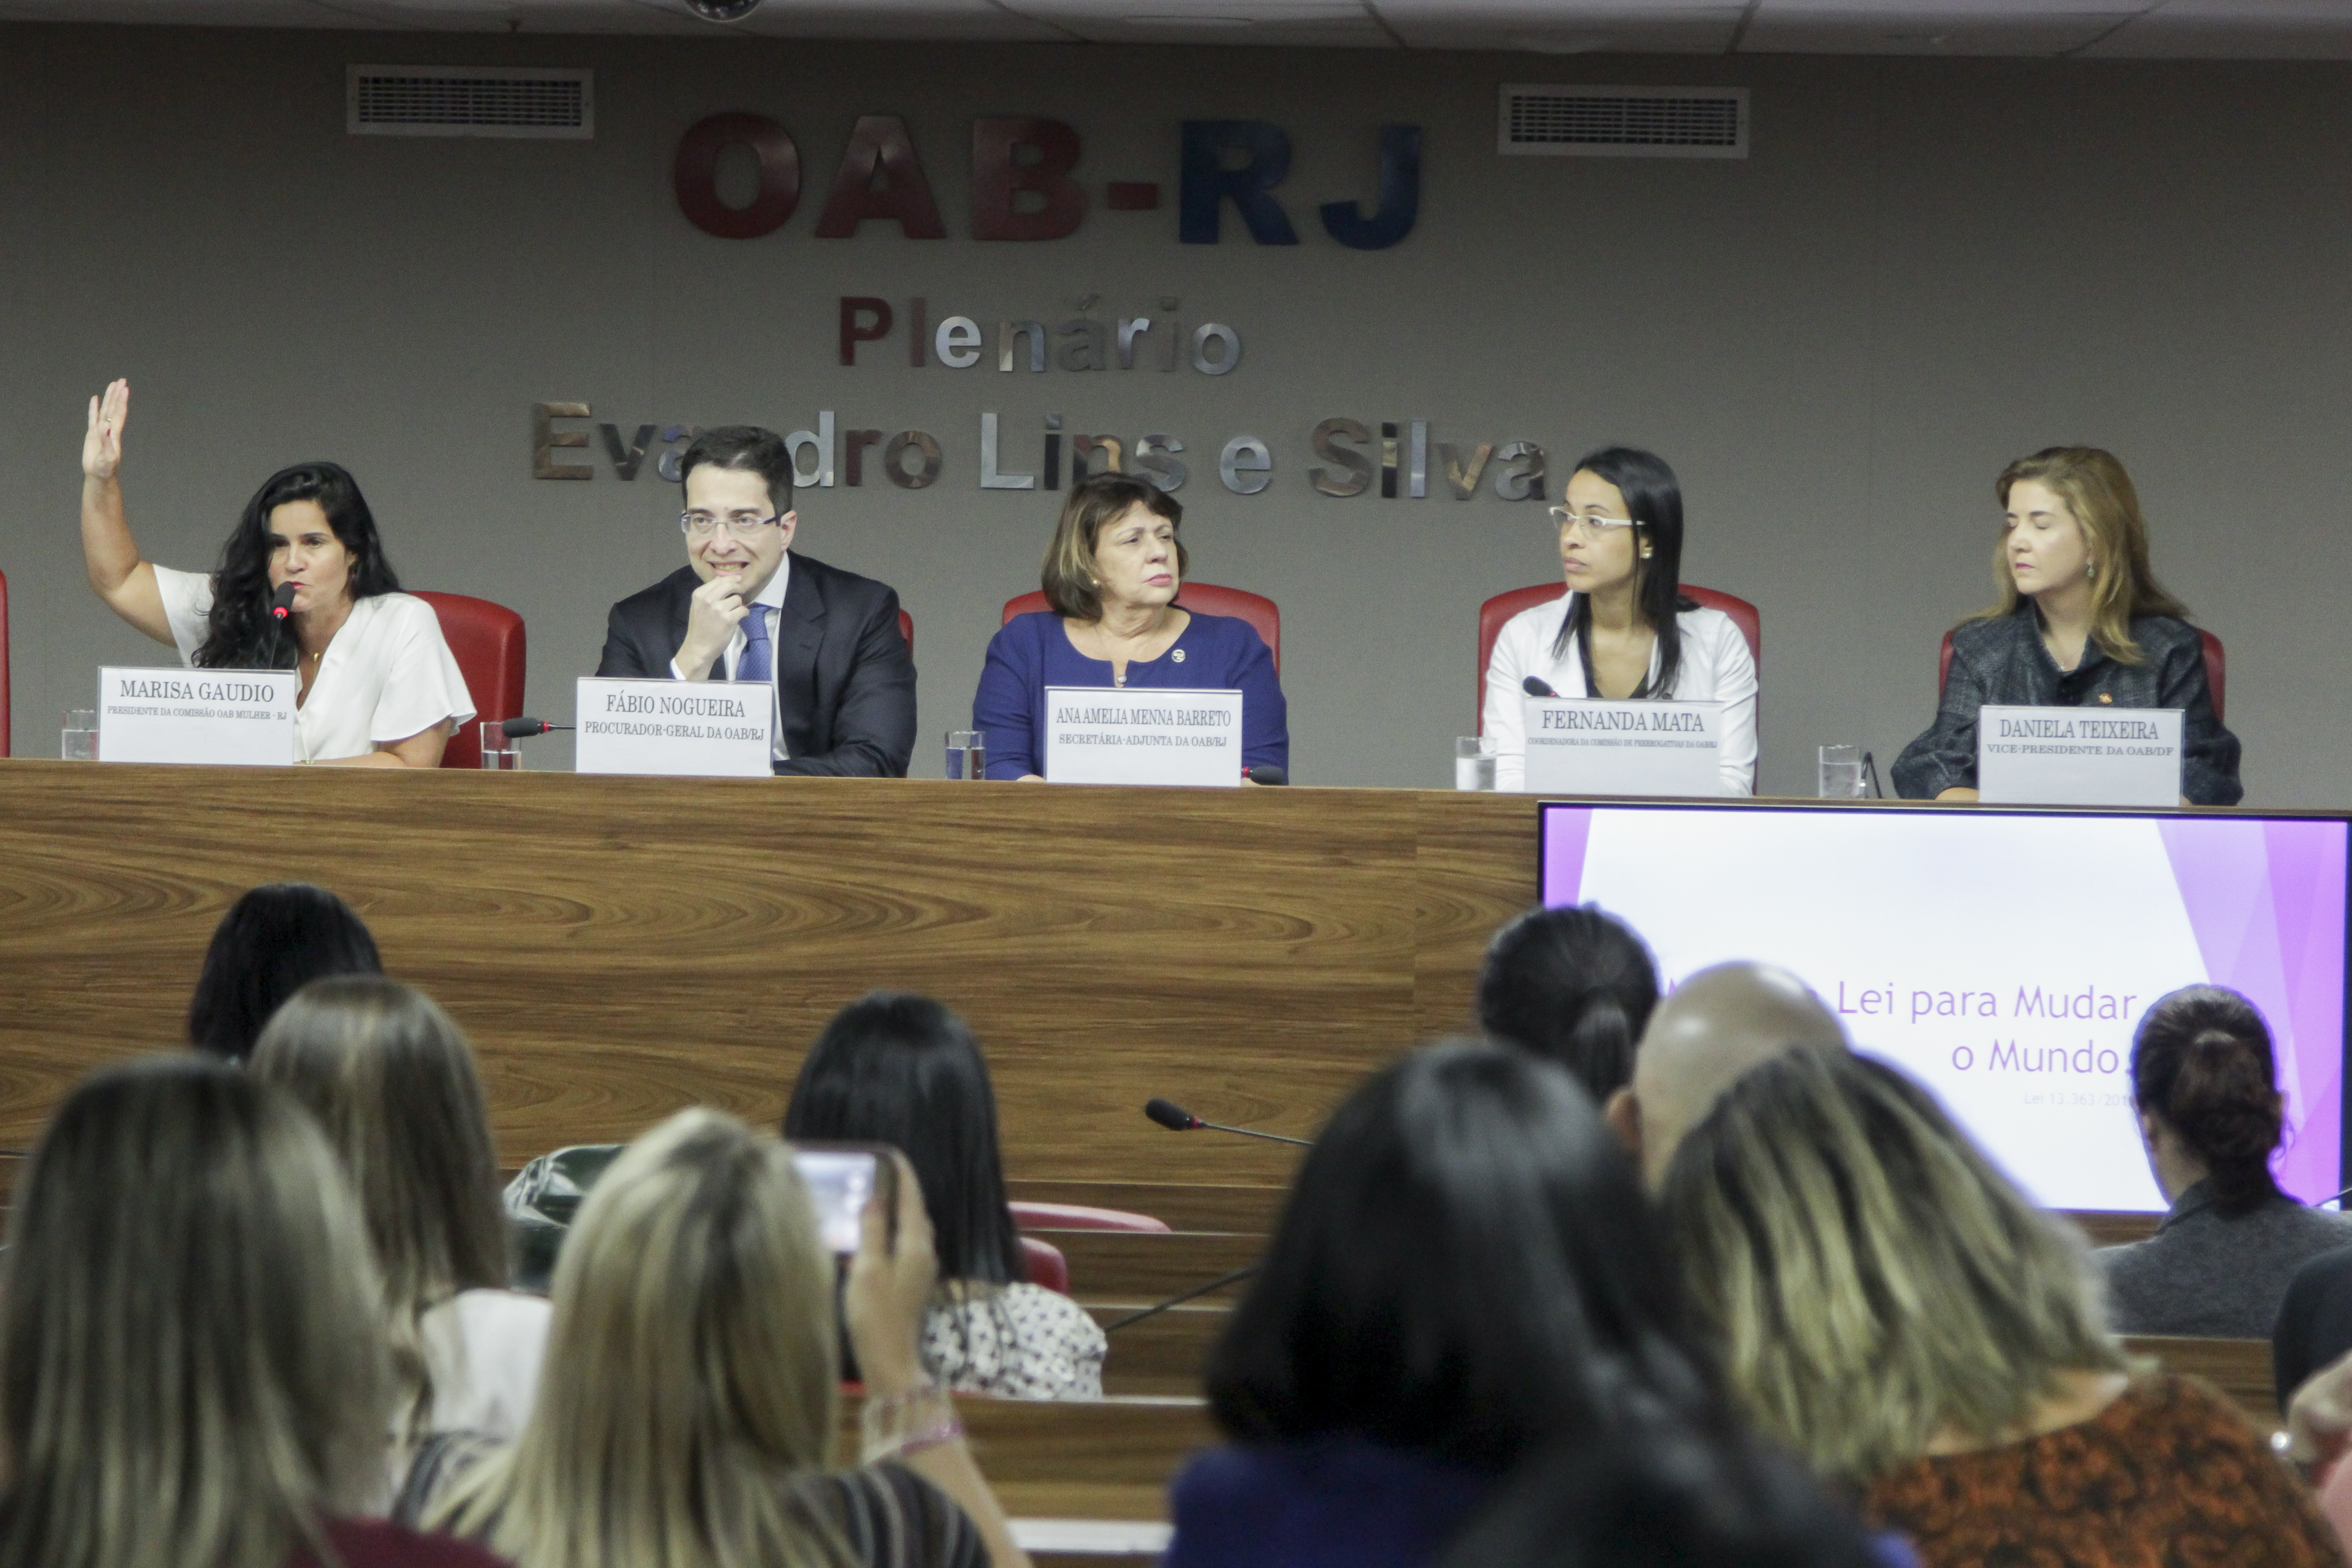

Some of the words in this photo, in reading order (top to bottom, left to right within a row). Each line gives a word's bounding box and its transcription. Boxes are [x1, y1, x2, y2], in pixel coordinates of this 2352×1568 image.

[674, 111, 1422, 251] OAB-RJ
[839, 294, 1240, 376] Plenário
[532, 402, 943, 489] Evadro
[980, 412, 1186, 492] Lins
[1220, 435, 1271, 494] e
[1309, 417, 1546, 500] Silva
[120, 680, 195, 699] MARISA
[199, 682, 274, 702] GAUDIO
[107, 706, 158, 715] PRESIDENTE
[161, 708, 172, 716] DA
[173, 707, 215, 718] COMISSÃO
[217, 710, 234, 718] OAB
[235, 710, 271, 720] MULHER
[277, 712, 287, 720] RJ
[606, 690, 655, 714] FÁBIO
[660, 696, 745, 717] NOGUEIRA
[1056, 707, 1081, 723] ANA
[1083, 708, 1128, 724] AMELIA
[1130, 709, 1174, 725] MENNA
[1176, 710, 1231, 726] BARRETO
[1542, 710, 1648, 731] FERNANDA
[1651, 712, 1705, 732] MATA
[584, 721, 704, 738] PROCURADOR-GERAL
[706, 727, 722, 739] DA
[725, 727, 764, 740] OAB/RJ
[1059, 732, 1172, 745] SECRETÁRIA-ADJUNTA
[1175, 736, 1189, 746] DA
[1191, 736, 1227, 747] OAB/RJ
[1999, 719, 2076, 738] DANIELA
[2079, 720, 2159, 740] TEIXEIRA
[1987, 744, 2102, 755] VICE-PRESIDENTE
[2107, 747, 2125, 755] DA
[2127, 747, 2174, 756] OAB/DF
[1838, 980, 1894, 1014] Lei
[1911, 988, 1997, 1024] para
[2014, 984, 2137, 1021] Mudar
[1951, 1046, 1974, 1071] o
[2024, 1092, 2043, 1104] Lei
